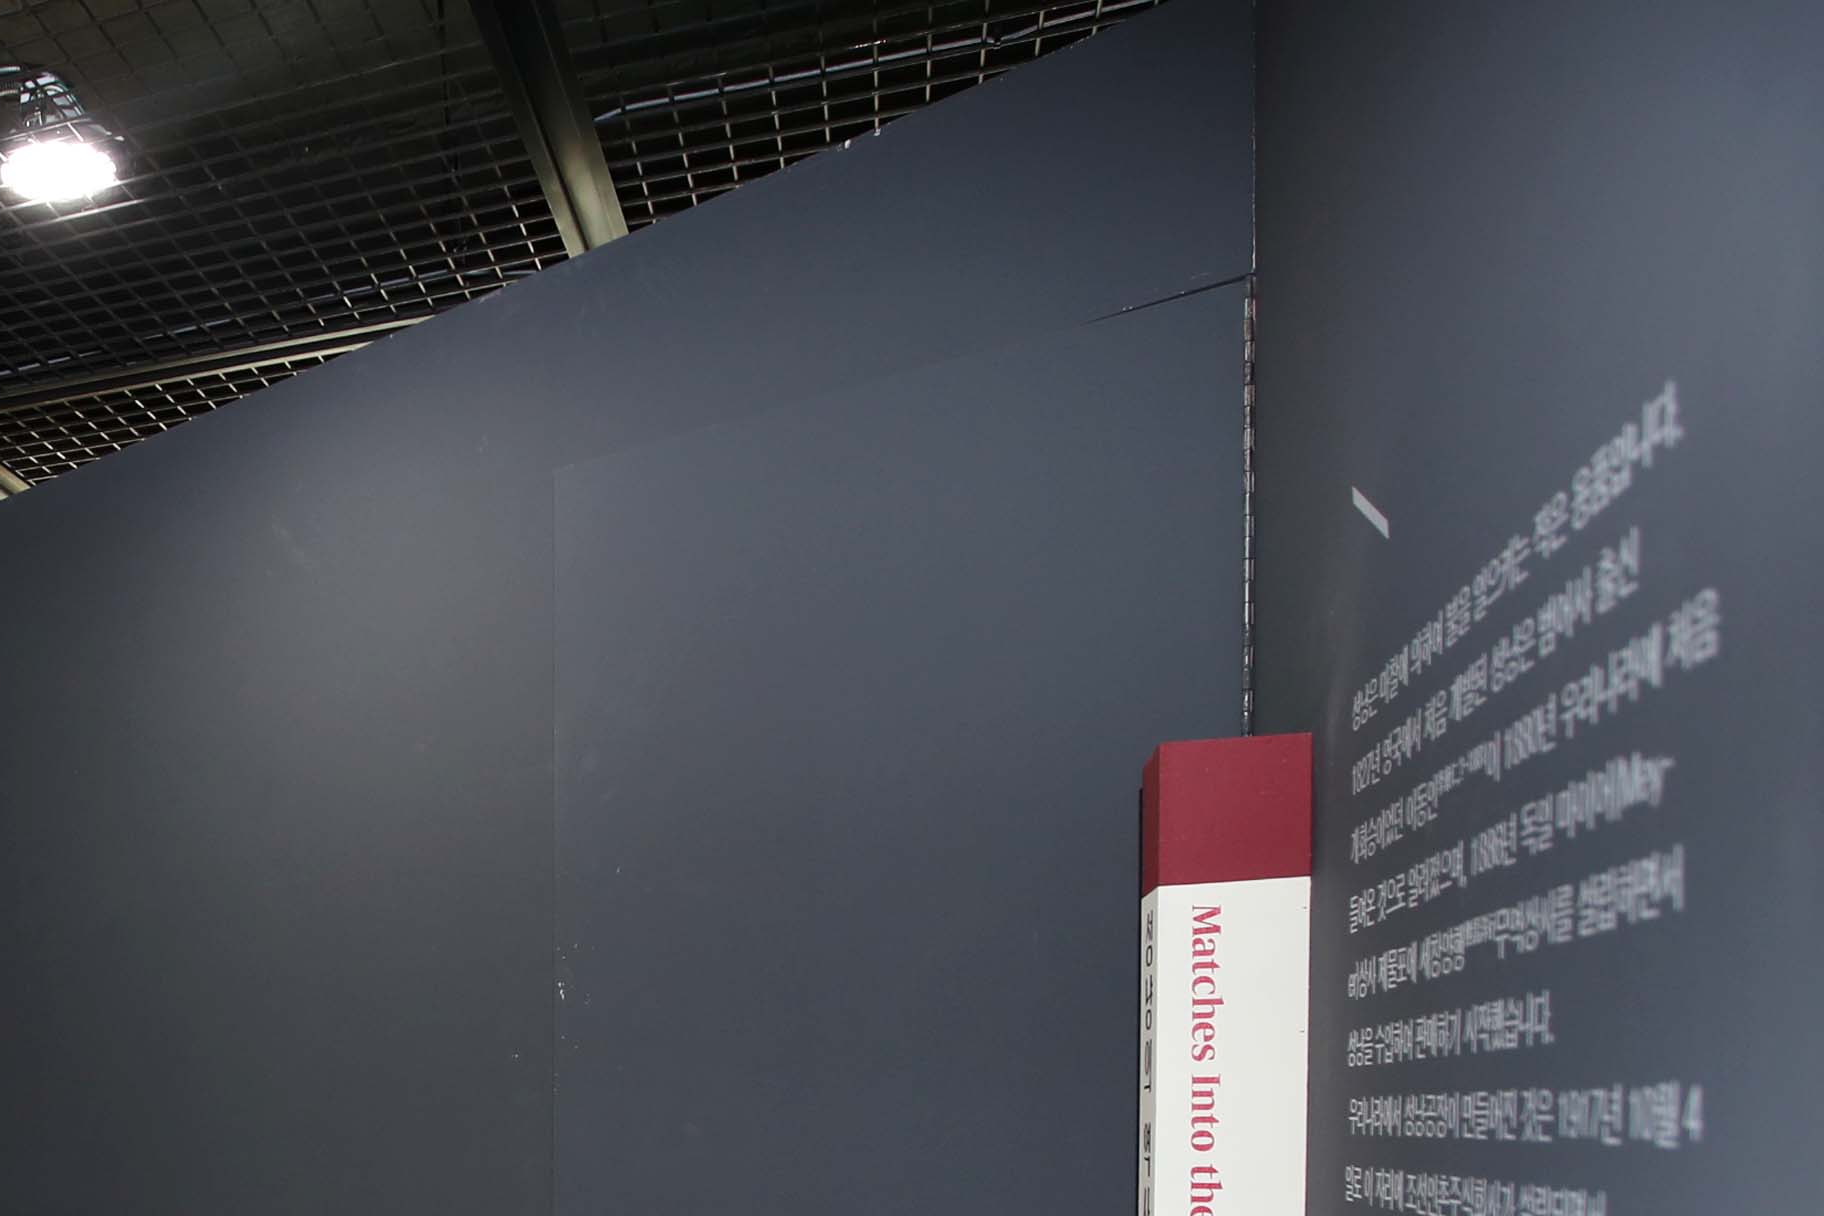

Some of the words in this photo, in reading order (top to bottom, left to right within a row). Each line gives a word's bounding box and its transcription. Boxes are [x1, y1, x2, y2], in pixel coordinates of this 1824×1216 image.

[1351, 676, 1381, 733] 성냥은
[1378, 643, 1410, 705] 마찰에
[1409, 609, 1445, 676] 의하여
[1444, 584, 1473, 649] 불을
[1381, 707, 1423, 777] 영국에서
[1423, 688, 1449, 742] 처음
[1449, 652, 1489, 722] 개발된
[1490, 616, 1538, 694] 성냥은
[1537, 566, 1594, 658] 범어사
[1595, 525, 1641, 615] 출신
[1350, 796, 1405, 866] 개화승이었던
[1559, 623, 1663, 739] 우리나라에
[1666, 586, 1722, 671] 처음
[1349, 887, 1378, 935] 들어온
[1377, 872, 1408, 923] 것으로
[1519, 793, 1555, 856] 독일
[1143, 909, 1154, 1094] 성냥의
[1191, 904, 1225, 1062] Matches
[1377, 940, 1419, 993] 제물포에
[1347, 1026, 1375, 1069] 성냥을
[1373, 1017, 1415, 1066] 수입하여
[1414, 1008, 1463, 1060] 판매하기
[1190, 1073, 1222, 1152] Into
[1348, 1094, 1404, 1138] 우리나라에서
[1461, 1089, 1519, 1142] 만들어진
[1519, 1087, 1556, 1144] 것은
[1345, 1163, 1364, 1203] 일로
[1363, 1166, 1375, 1208] 이
[1374, 1167, 1405, 1213] 자리에
